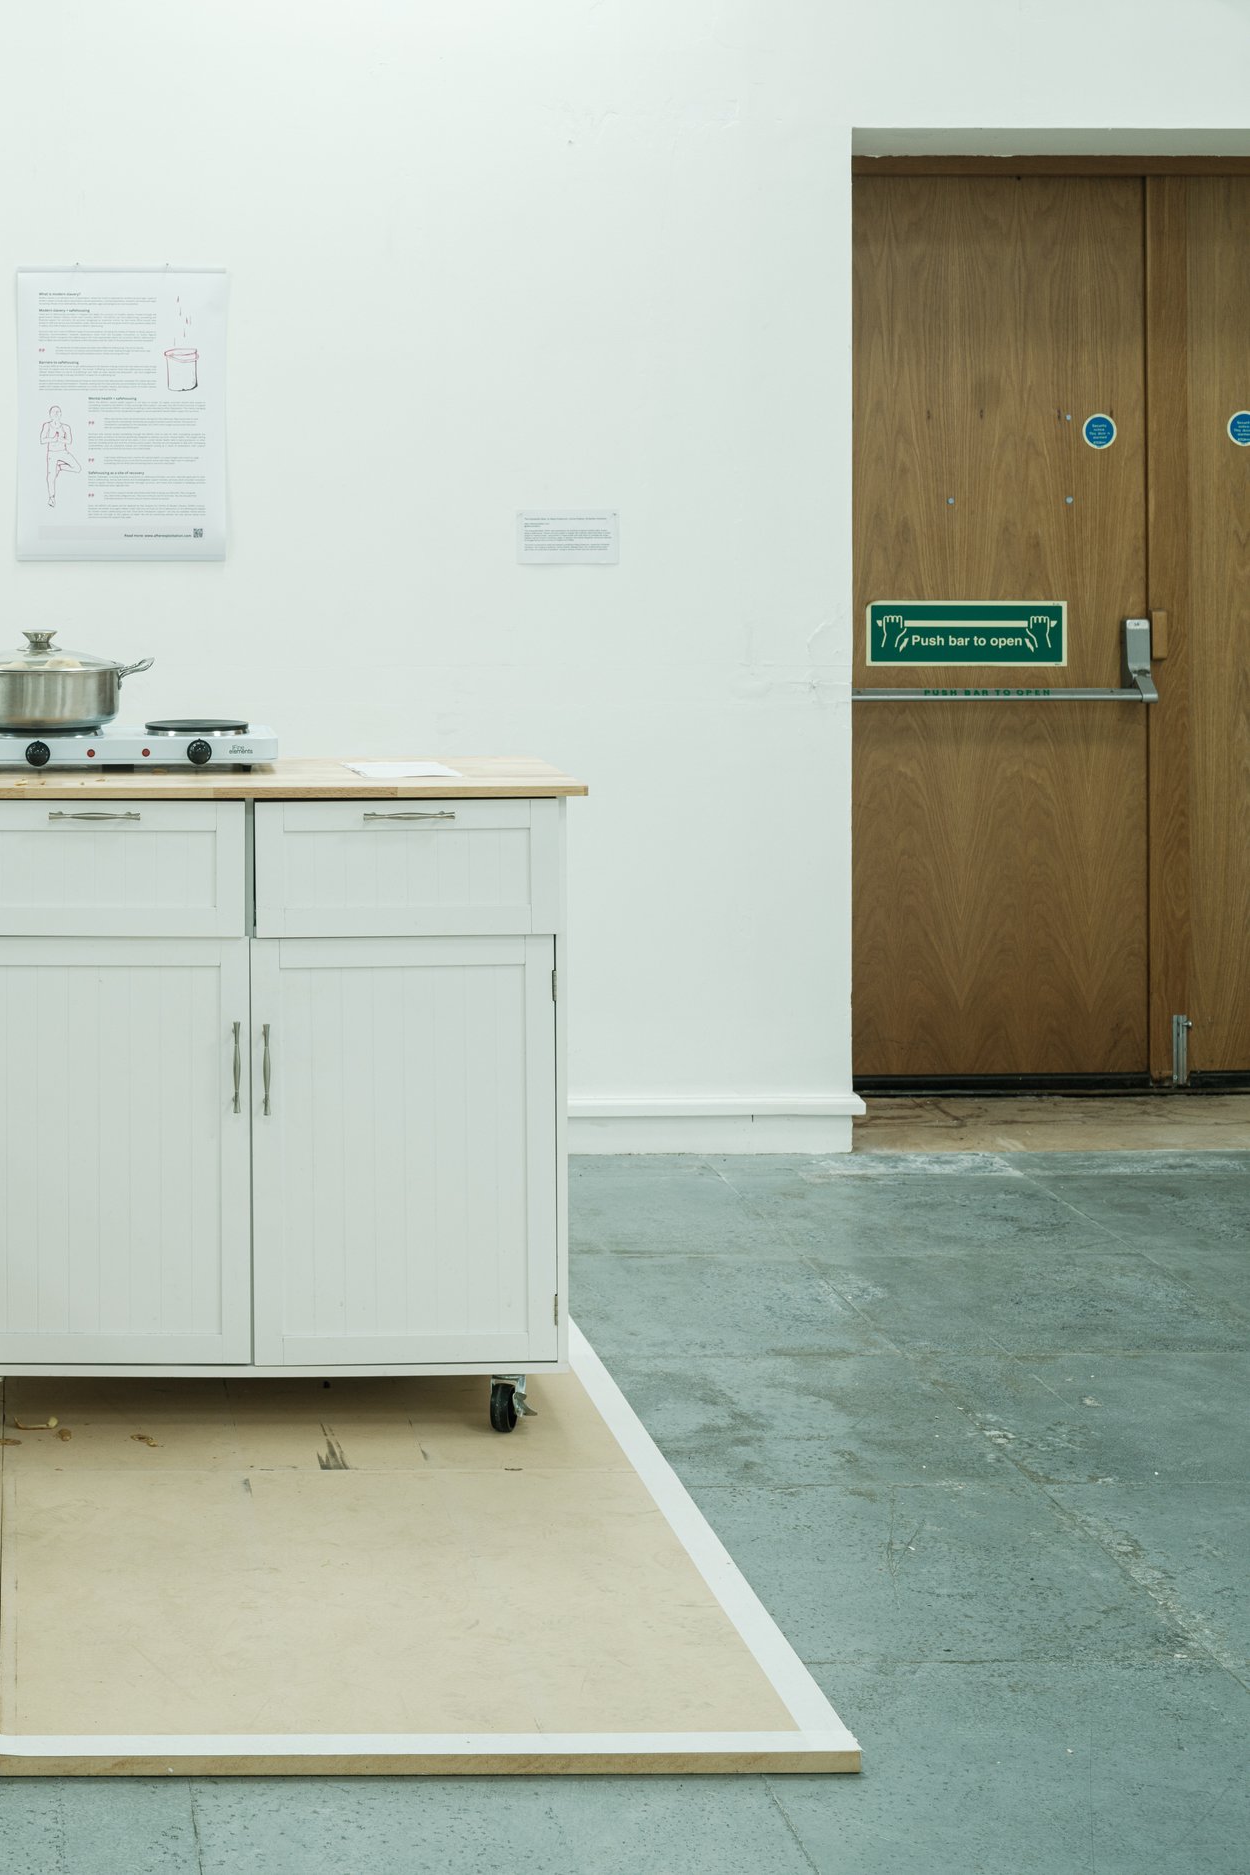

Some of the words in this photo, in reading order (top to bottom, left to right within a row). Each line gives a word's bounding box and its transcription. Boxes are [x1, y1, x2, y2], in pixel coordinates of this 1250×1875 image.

[912, 635, 944, 646] Push
[949, 635, 970, 646] bar
[973, 636, 987, 646] to
[990, 638, 1022, 650] open
